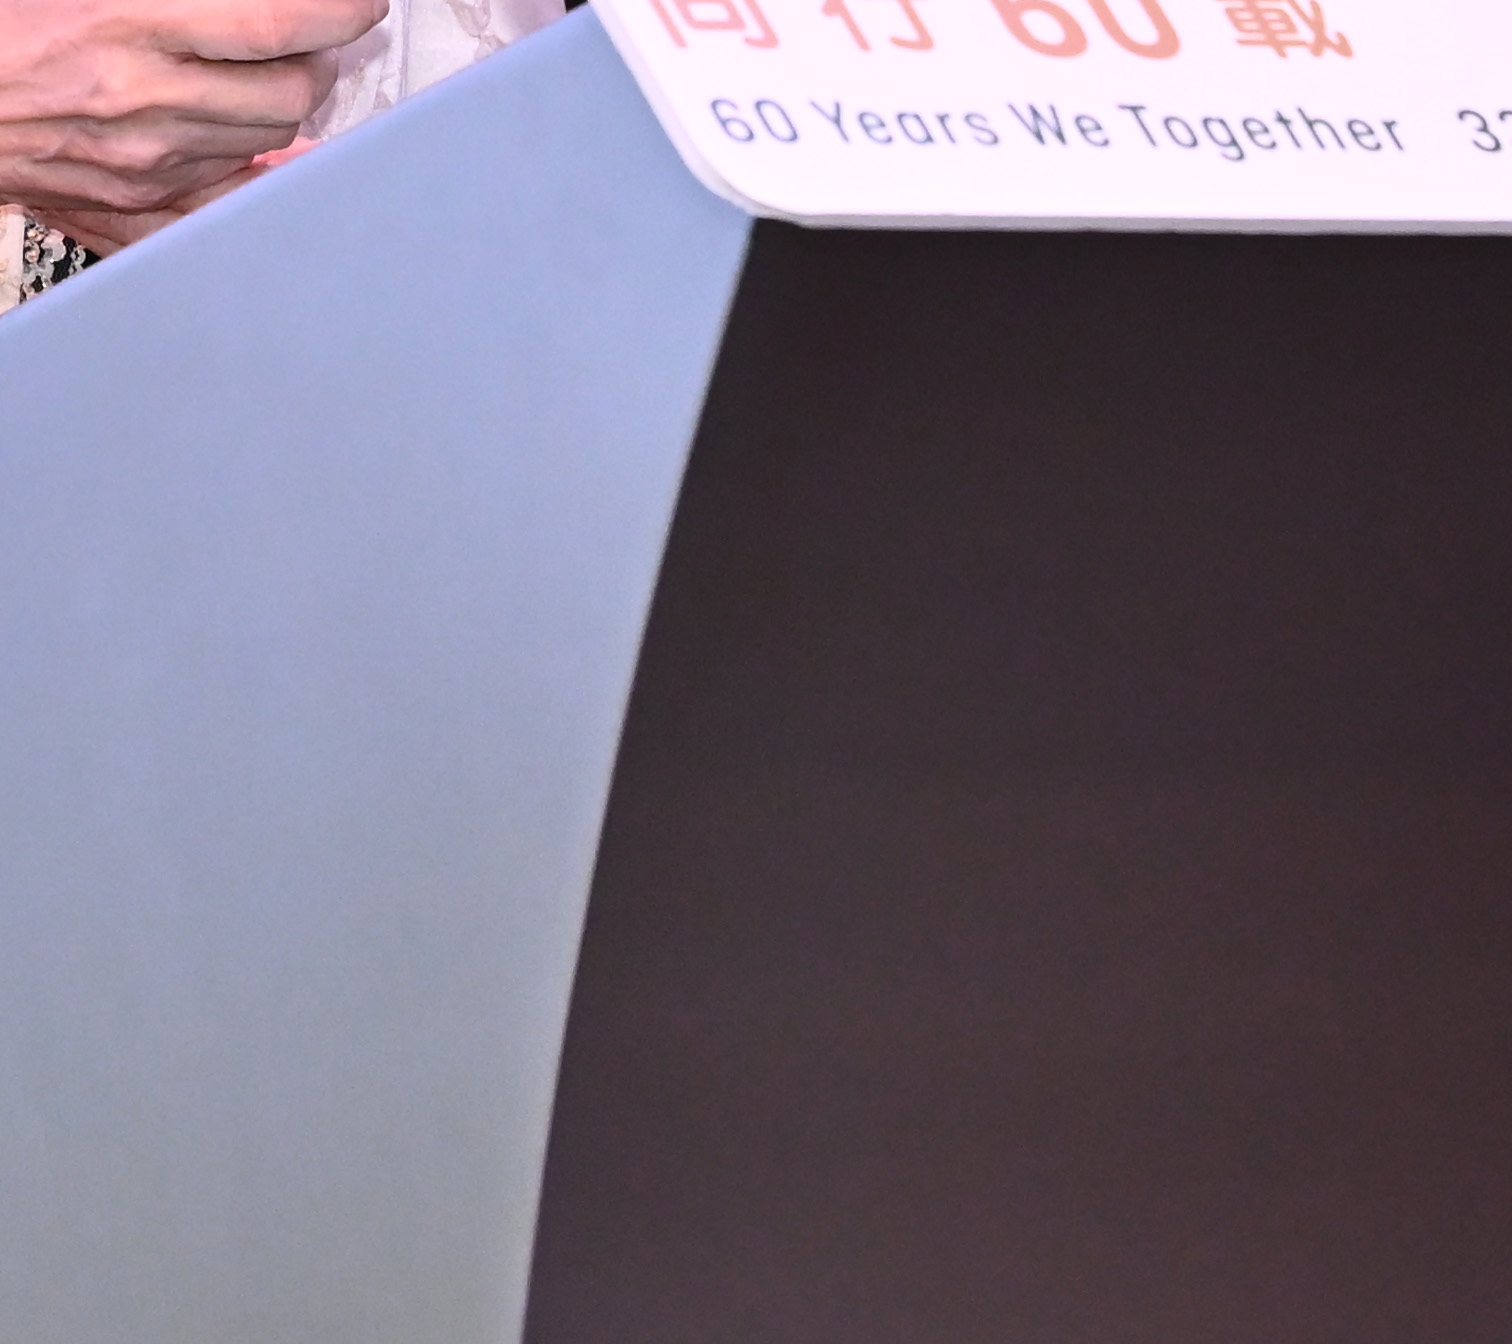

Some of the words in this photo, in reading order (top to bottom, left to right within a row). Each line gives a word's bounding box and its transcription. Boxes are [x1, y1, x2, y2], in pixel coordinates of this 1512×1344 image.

[710, 98, 799, 144] 60
[812, 101, 1000, 147] Years
[1007, 103, 1111, 149] We
[1118, 103, 1404, 162] Together
